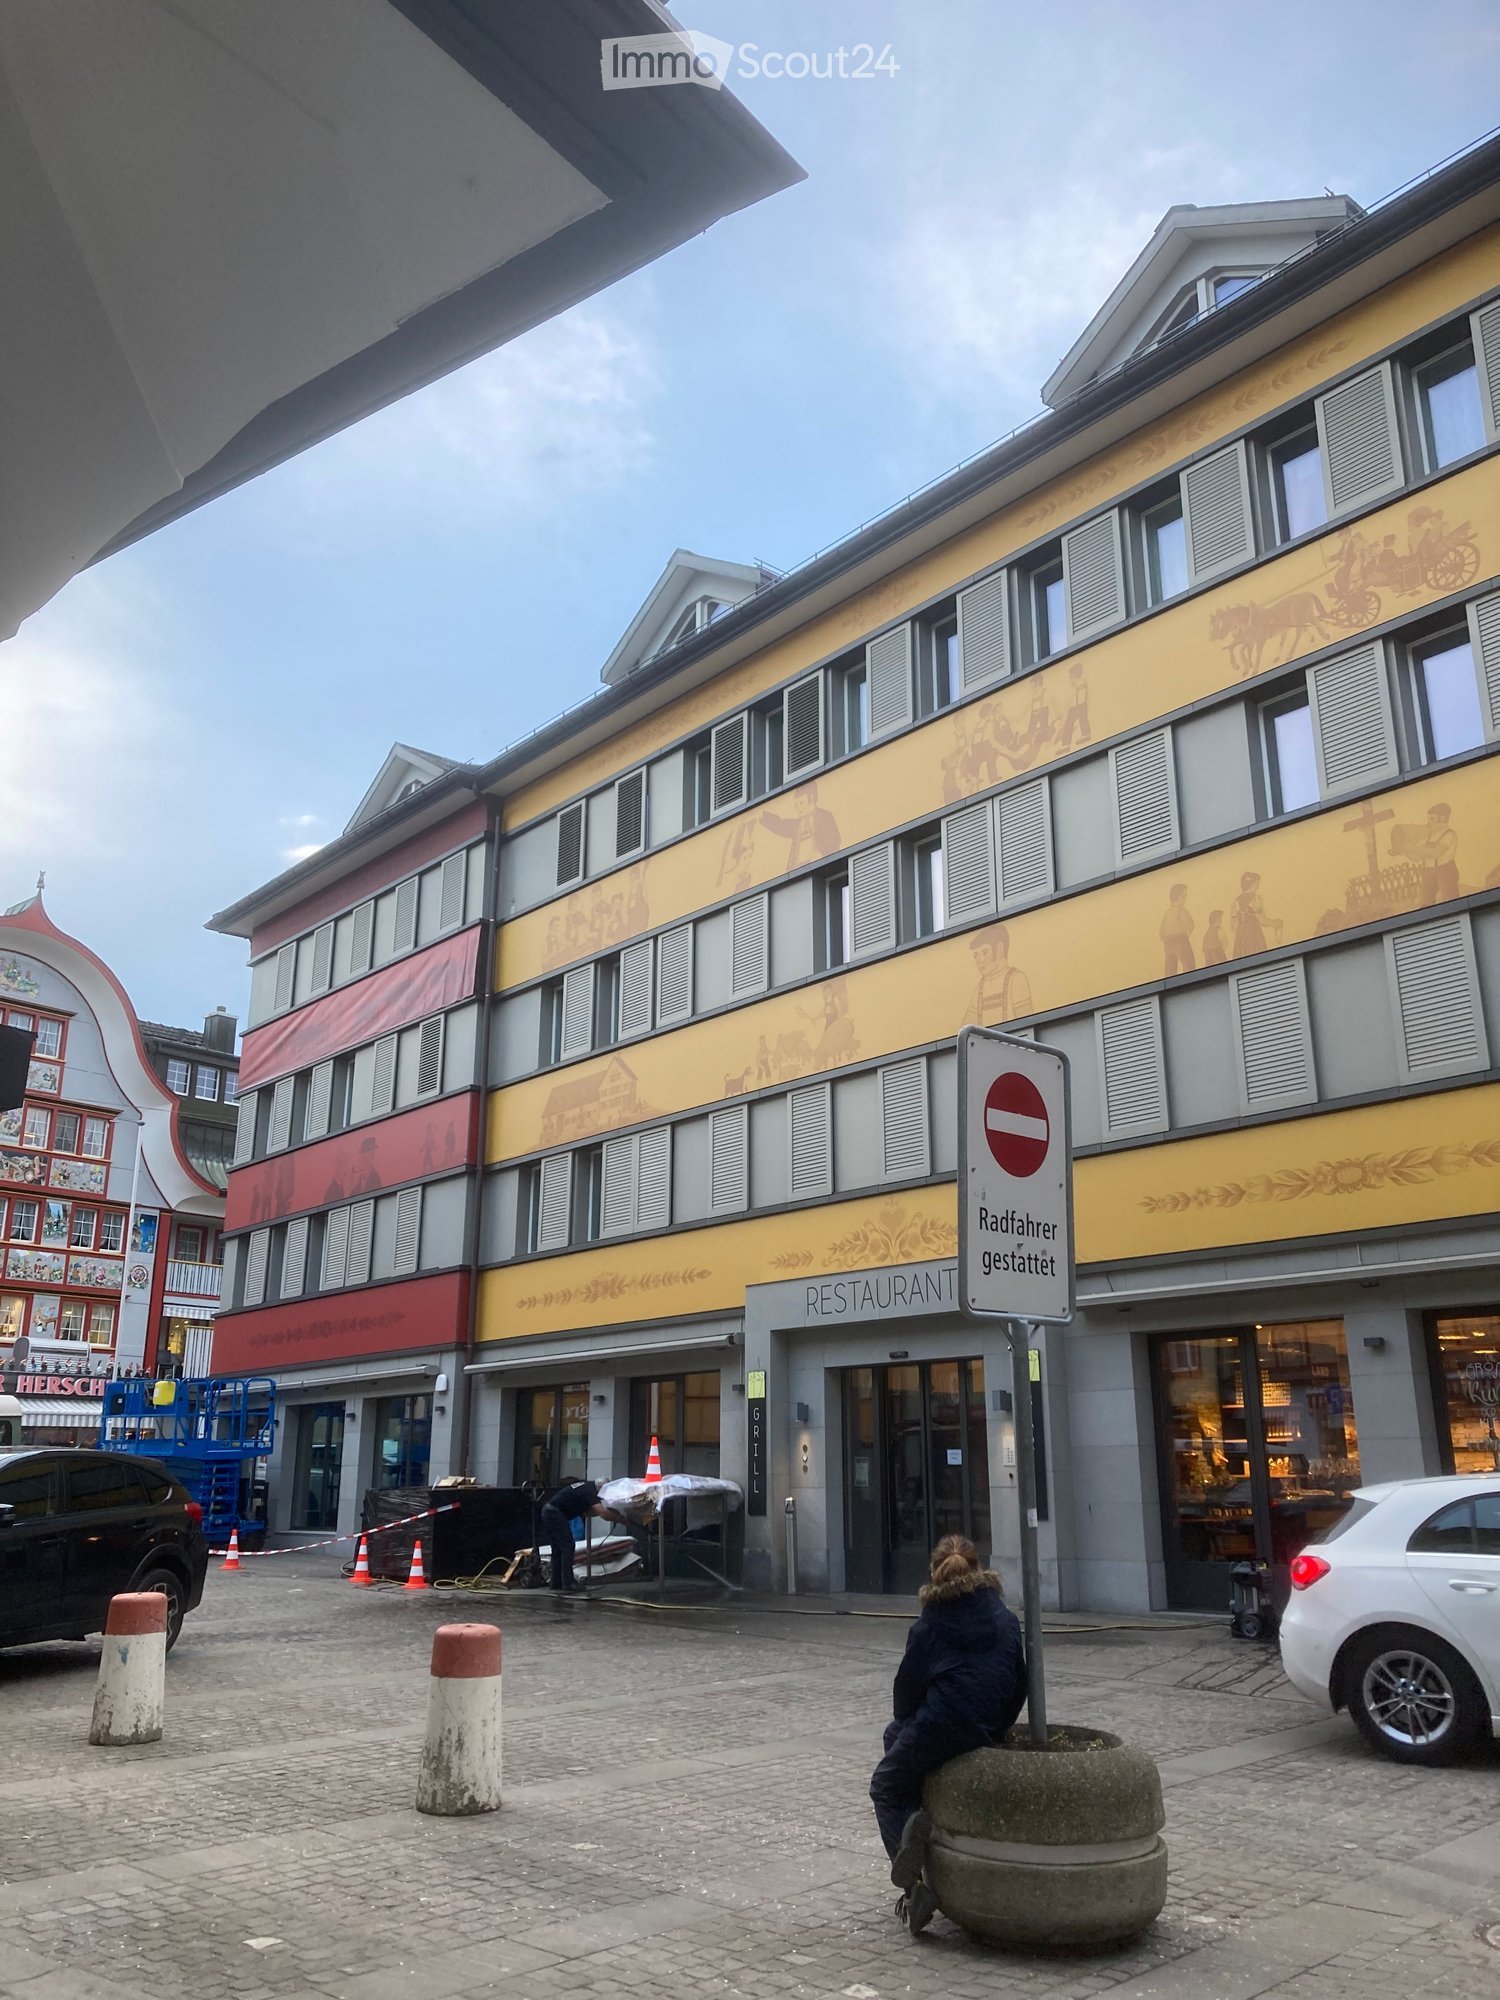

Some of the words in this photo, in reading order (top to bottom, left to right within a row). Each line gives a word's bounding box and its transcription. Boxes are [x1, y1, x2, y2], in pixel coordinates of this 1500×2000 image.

[979, 1206, 1058, 1241] Radfahrer
[982, 1250, 1056, 1277] gestattet
[806, 1268, 958, 1317] RESTAURANT
[16, 1374, 112, 1397] HERSCH
